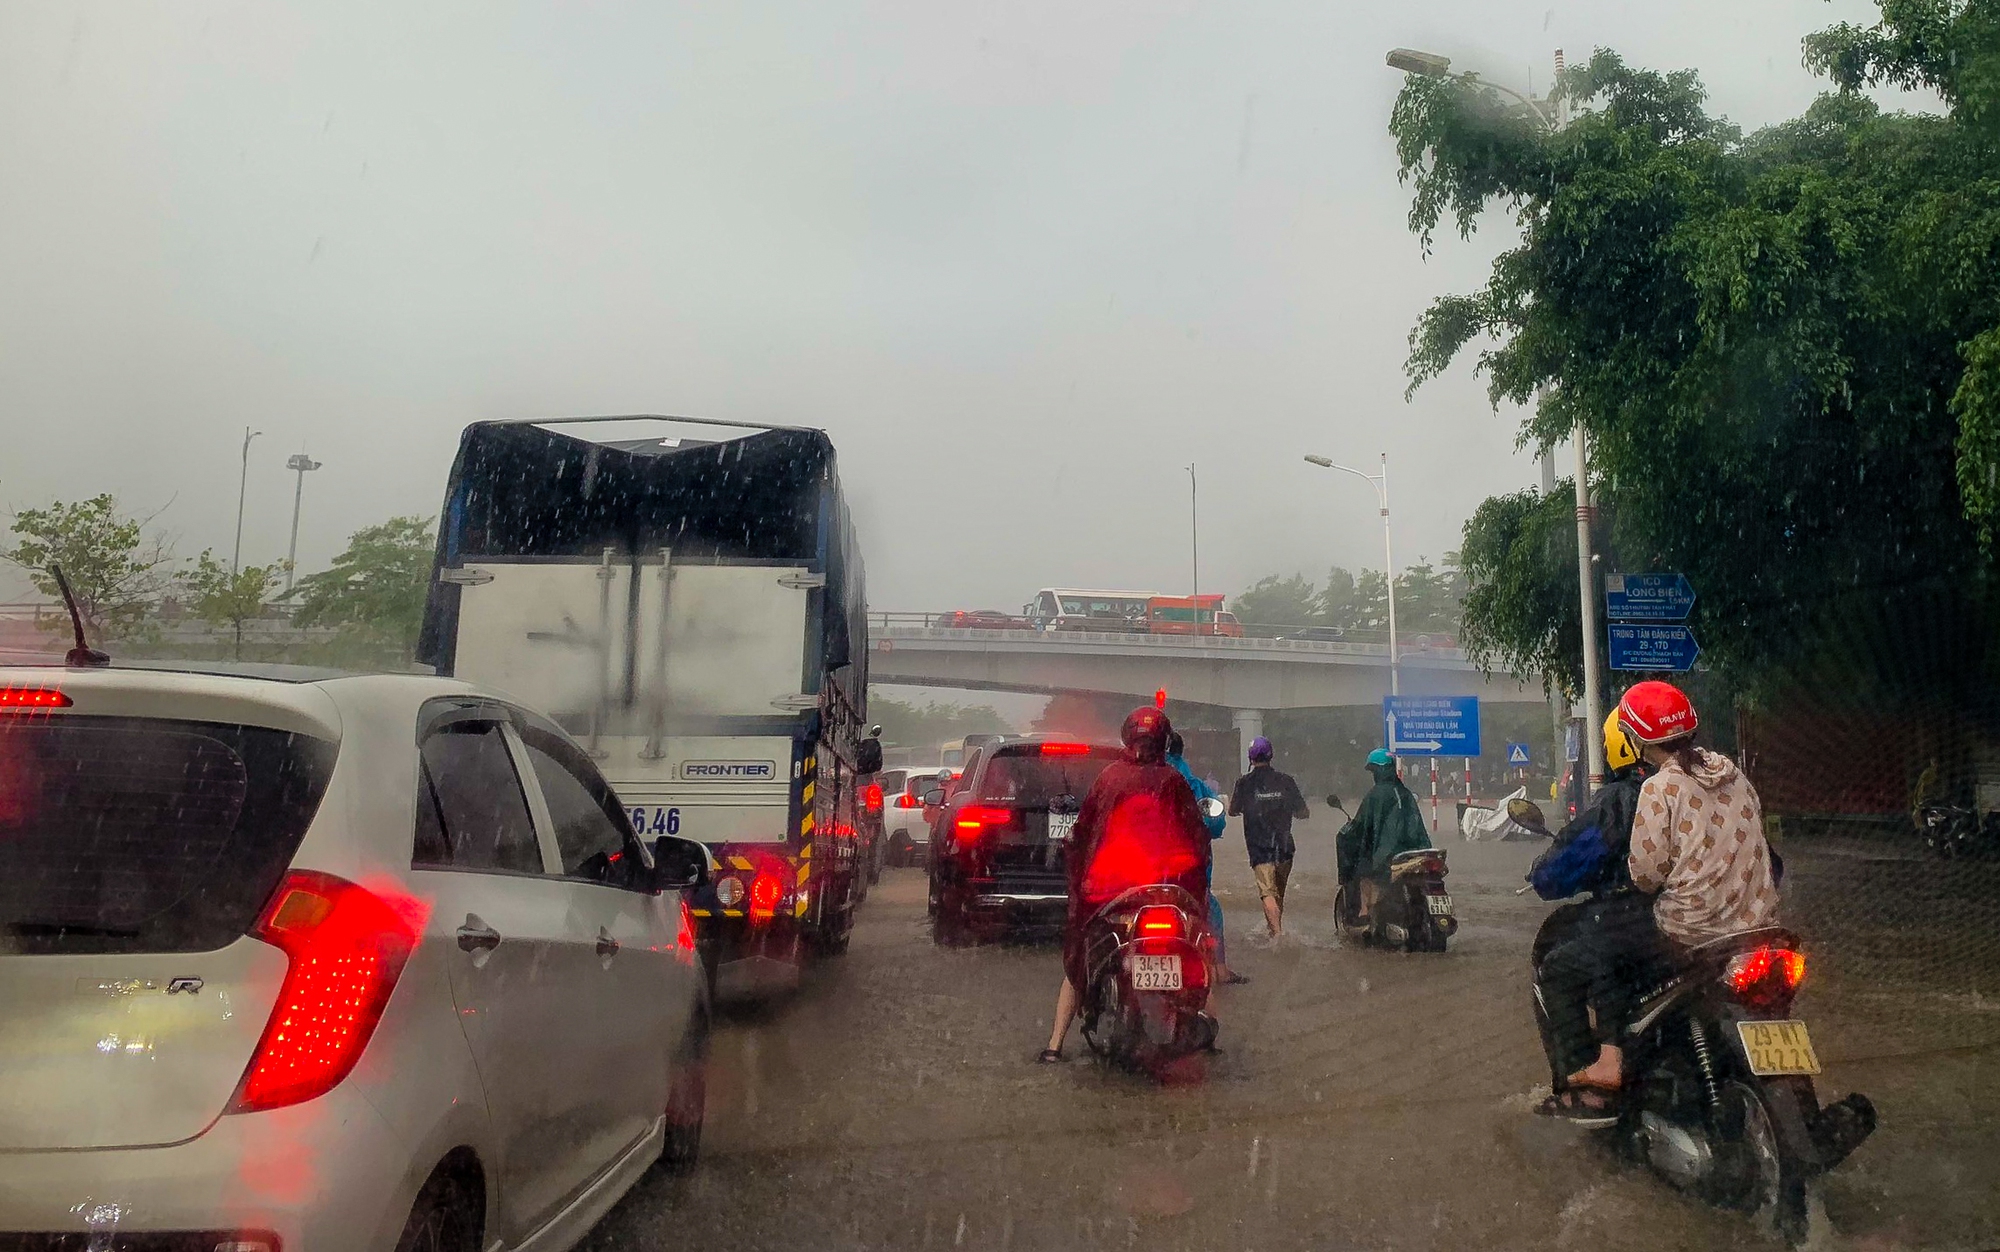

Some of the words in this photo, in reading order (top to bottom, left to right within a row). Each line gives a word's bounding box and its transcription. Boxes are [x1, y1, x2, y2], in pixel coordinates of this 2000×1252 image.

[1643, 577, 1661, 586] ICD
[1626, 588, 1656, 597] LONG
[1612, 629, 1634, 639] TRUNG
[1440, 709, 1462, 717] Stadium
[1425, 731, 1442, 739] Indoor
[1443, 731, 1466, 739] Stadium
[686, 765, 770, 775] FRONTIER
[624, 807, 681, 835] 6.46
[1140, 956, 1174, 971] 34-E1
[1135, 972, 1180, 988] 232.29
